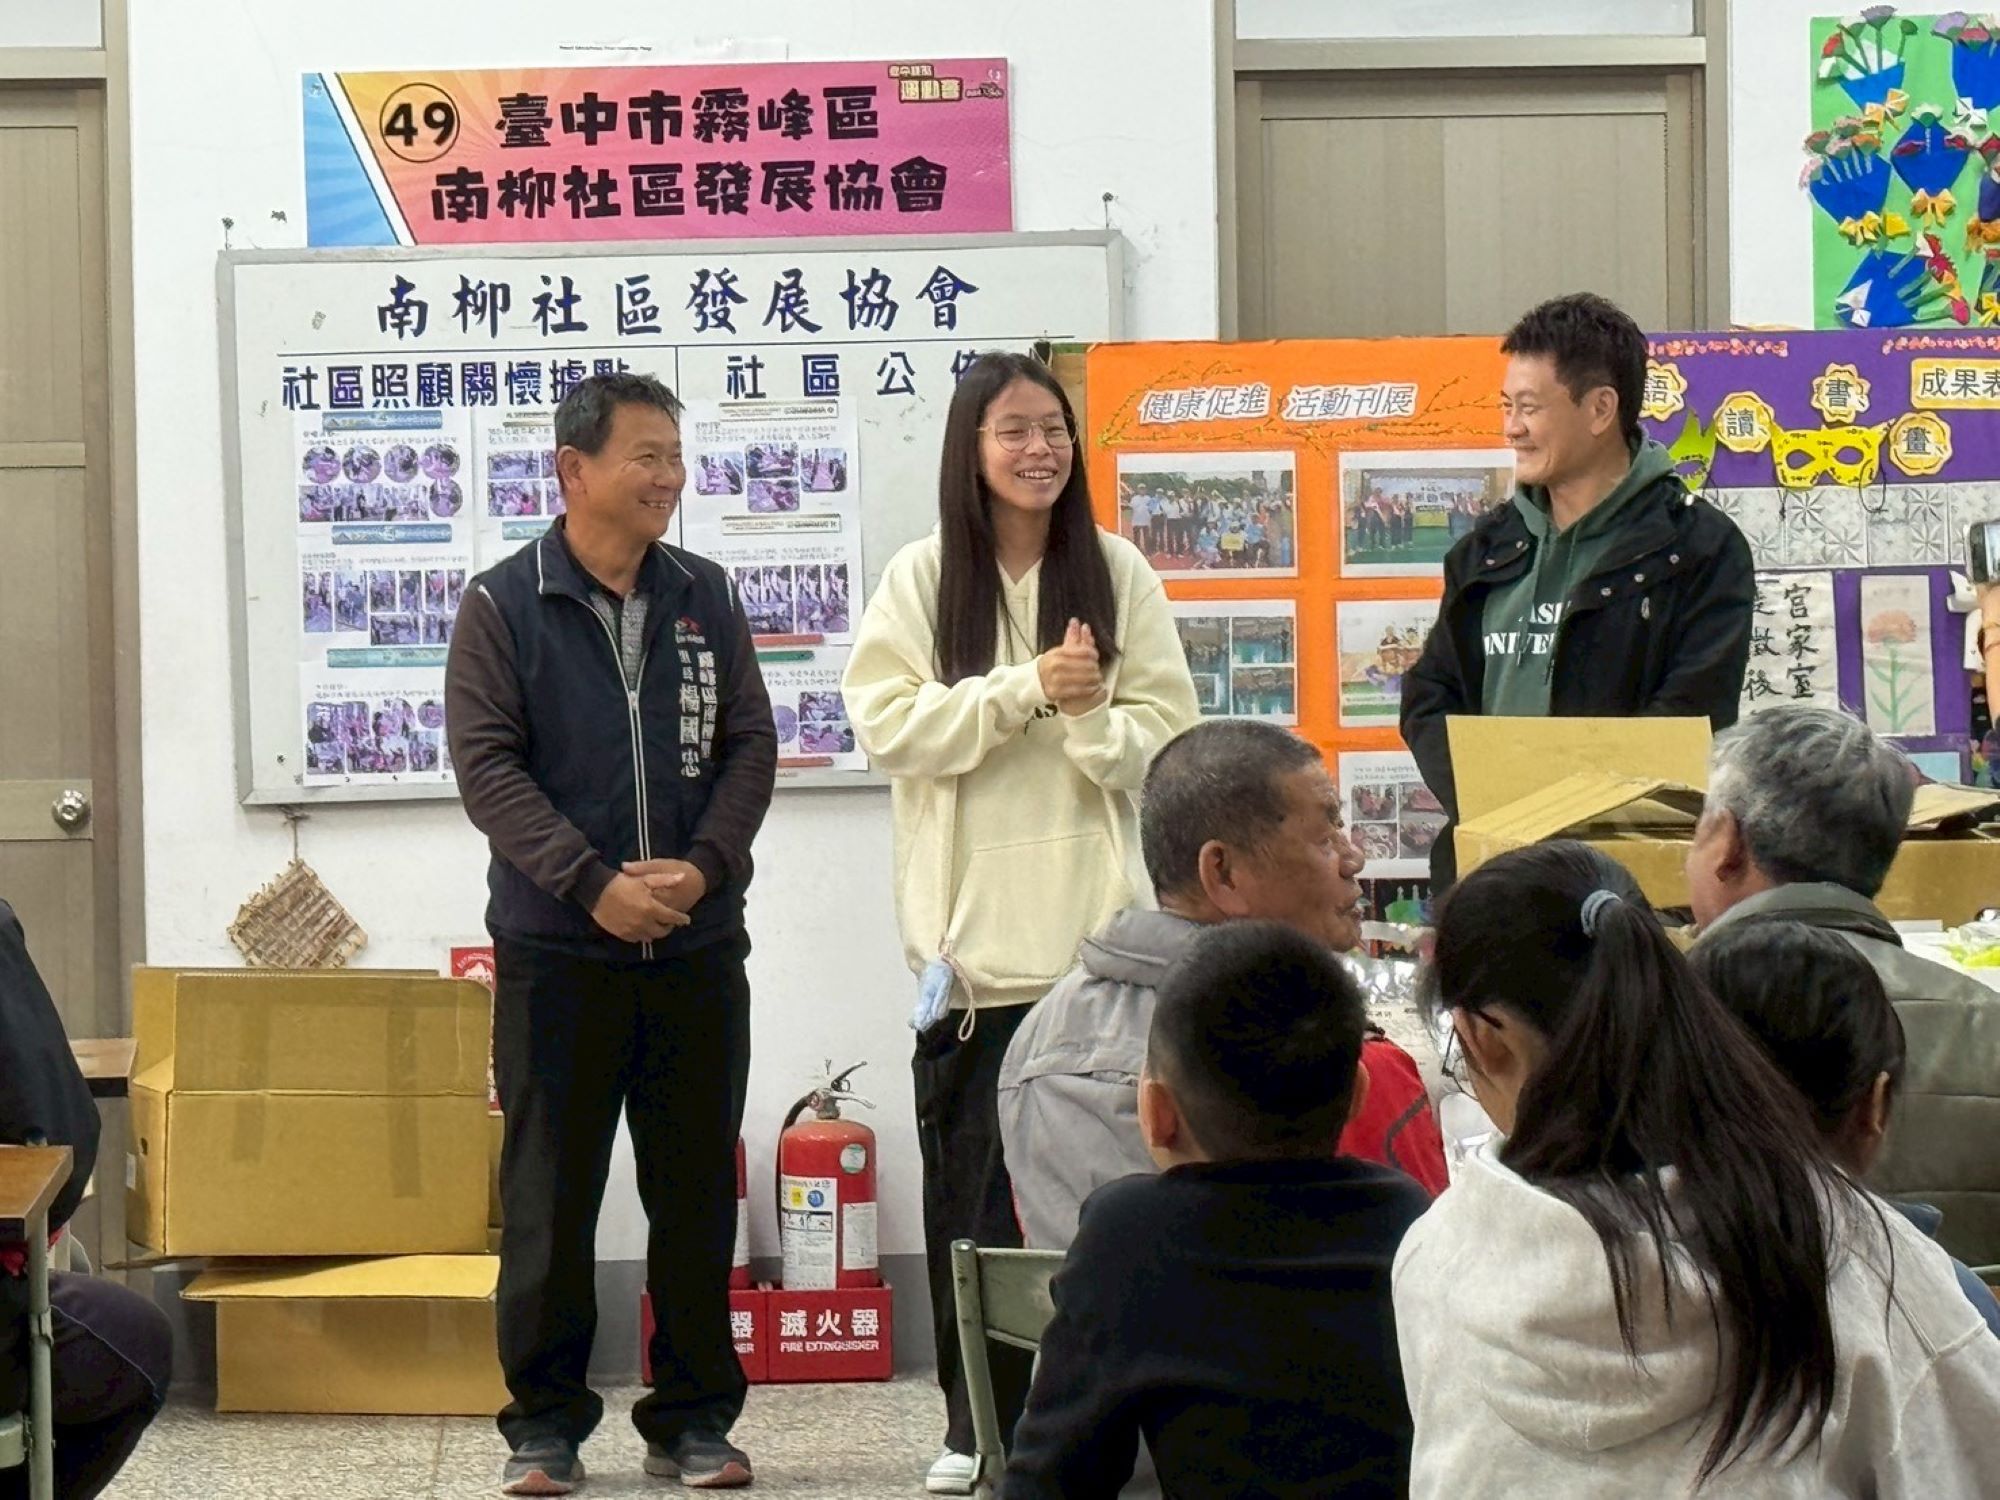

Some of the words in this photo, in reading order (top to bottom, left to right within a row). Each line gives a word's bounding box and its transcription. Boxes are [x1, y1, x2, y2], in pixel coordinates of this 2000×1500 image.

[384, 101, 456, 147] 49
[495, 86, 879, 148] 臺中市霧峰區
[432, 156, 947, 223] 南柳社區發展協會
[377, 265, 979, 340] 南柳社區發展協會
[1142, 384, 1269, 421] 健康促進
[1825, 377, 1852, 407] 書
[780, 1309, 880, 1337] 滅火器
[780, 1342, 804, 1352] FIRE
